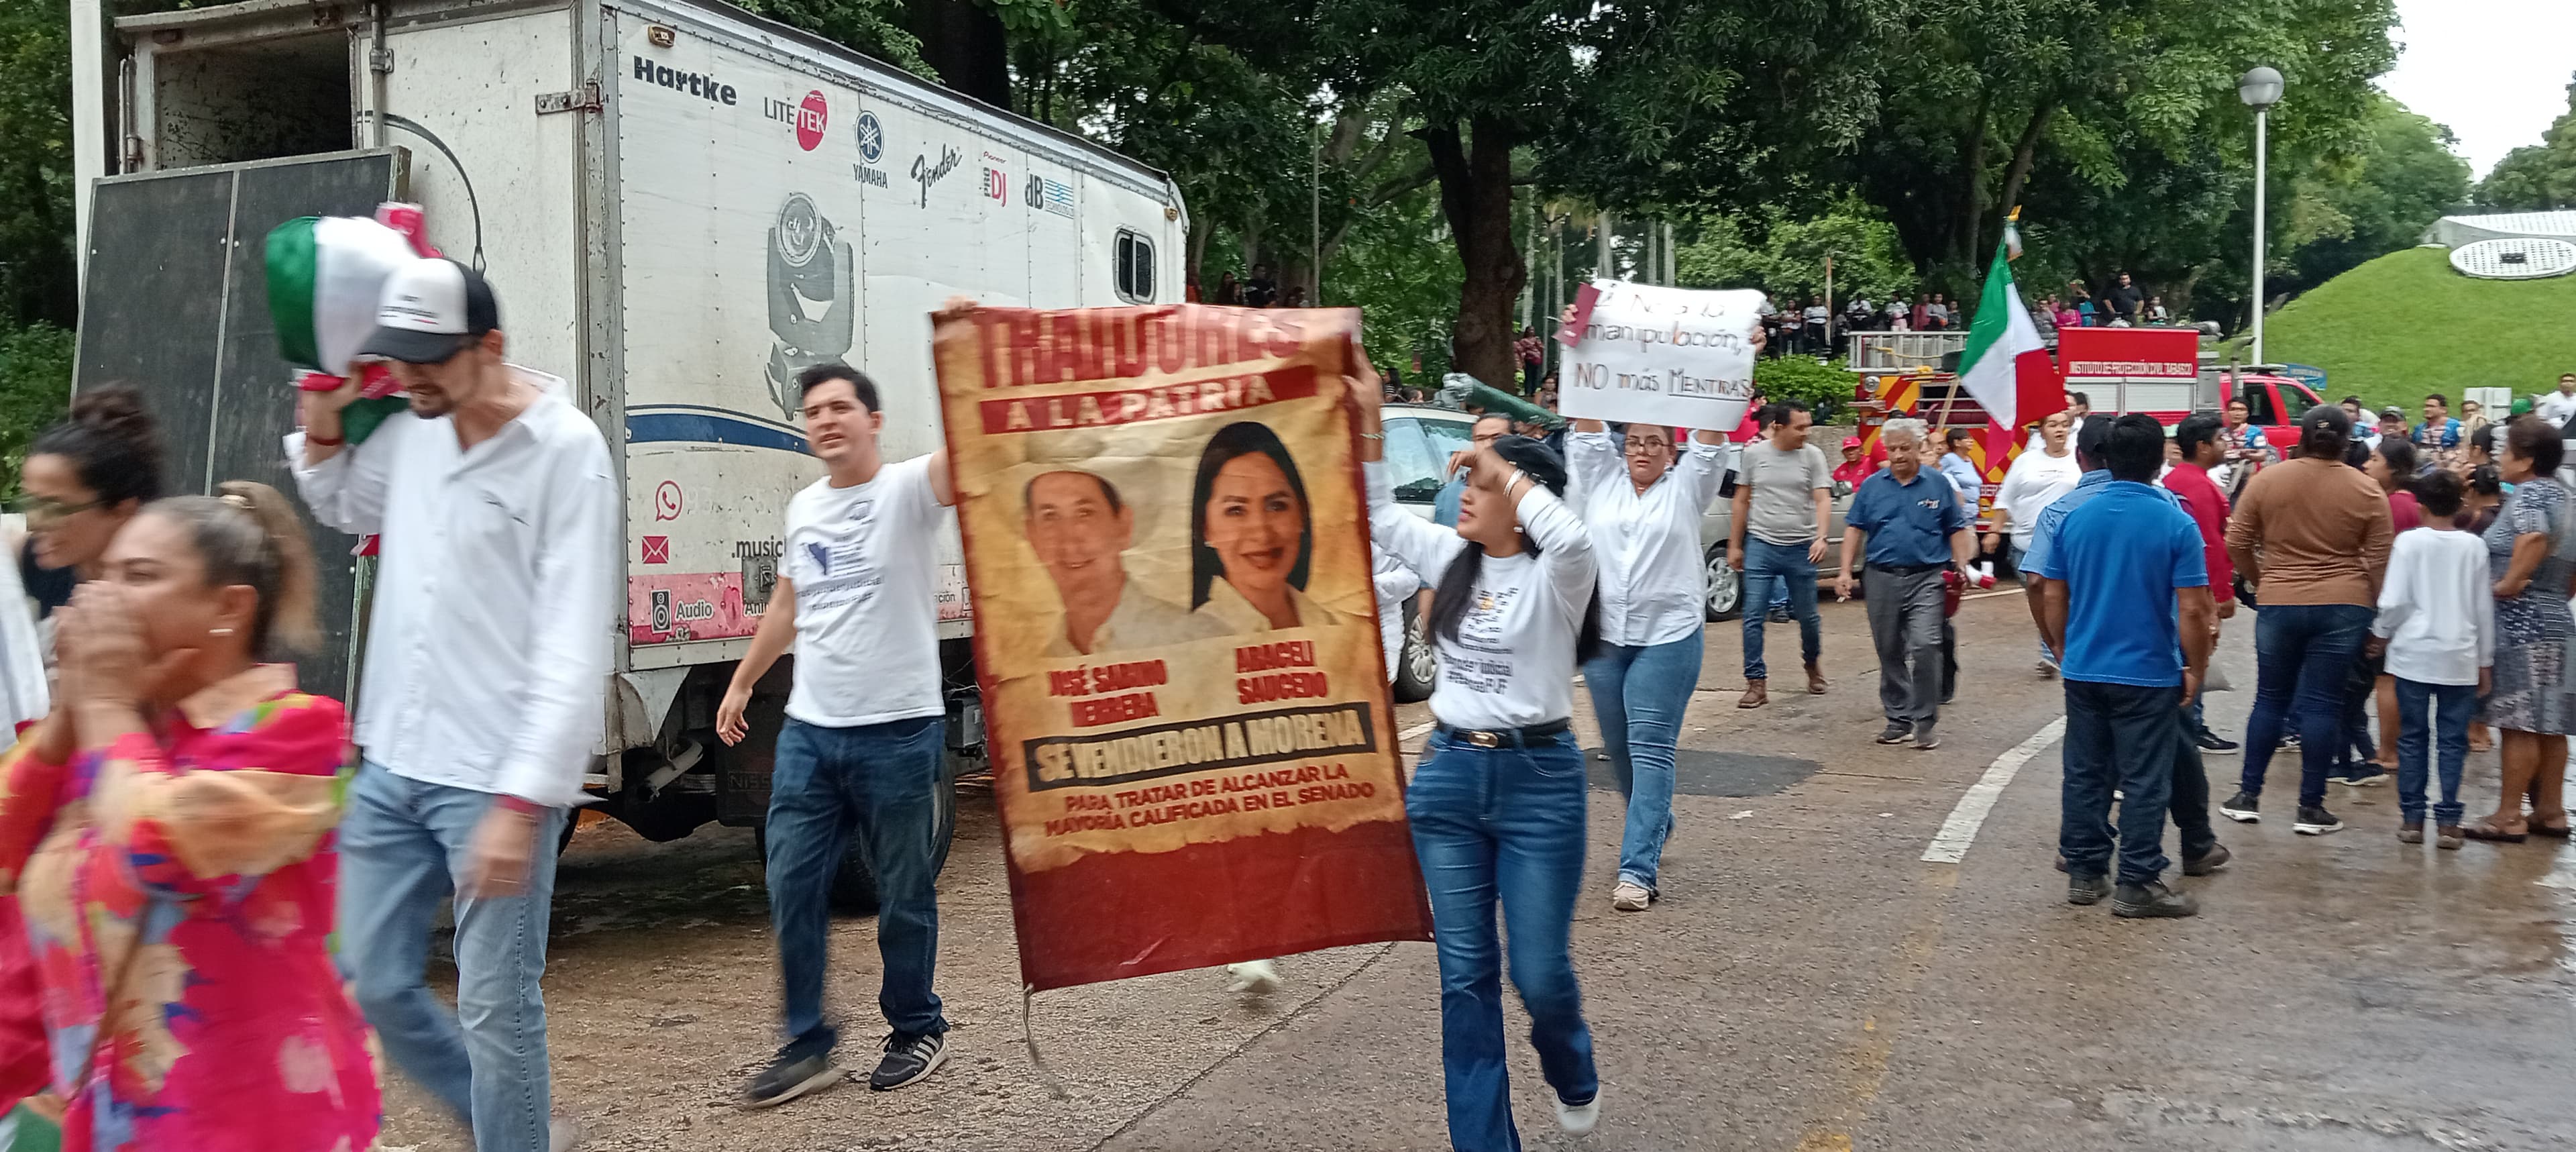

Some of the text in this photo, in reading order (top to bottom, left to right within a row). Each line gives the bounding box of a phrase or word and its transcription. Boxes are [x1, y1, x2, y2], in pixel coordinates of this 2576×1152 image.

[633, 55, 737, 105] Hartke
[853, 164, 889, 189] YAMAHA
[910, 143, 963, 209] Fender
[991, 169, 1007, 207] DJ
[1024, 174, 1043, 209] dB
[1574, 362, 1609, 390] NO
[1615, 368, 1659, 392] más
[1008, 374, 1276, 429] A LA PATRIA
[676, 599, 713, 620] Audio
[1234, 640, 1317, 674] ARACELI
[1237, 672, 1327, 705] SAUCEDO
[1035, 709, 1367, 782] SE VENDIERON A MORENA
[1065, 763, 1350, 812] PARA TRATAR DE ALCANZAR LA
[1044, 782, 1376, 837] MAYORÍA CALIFICADA EN EL SENADO
